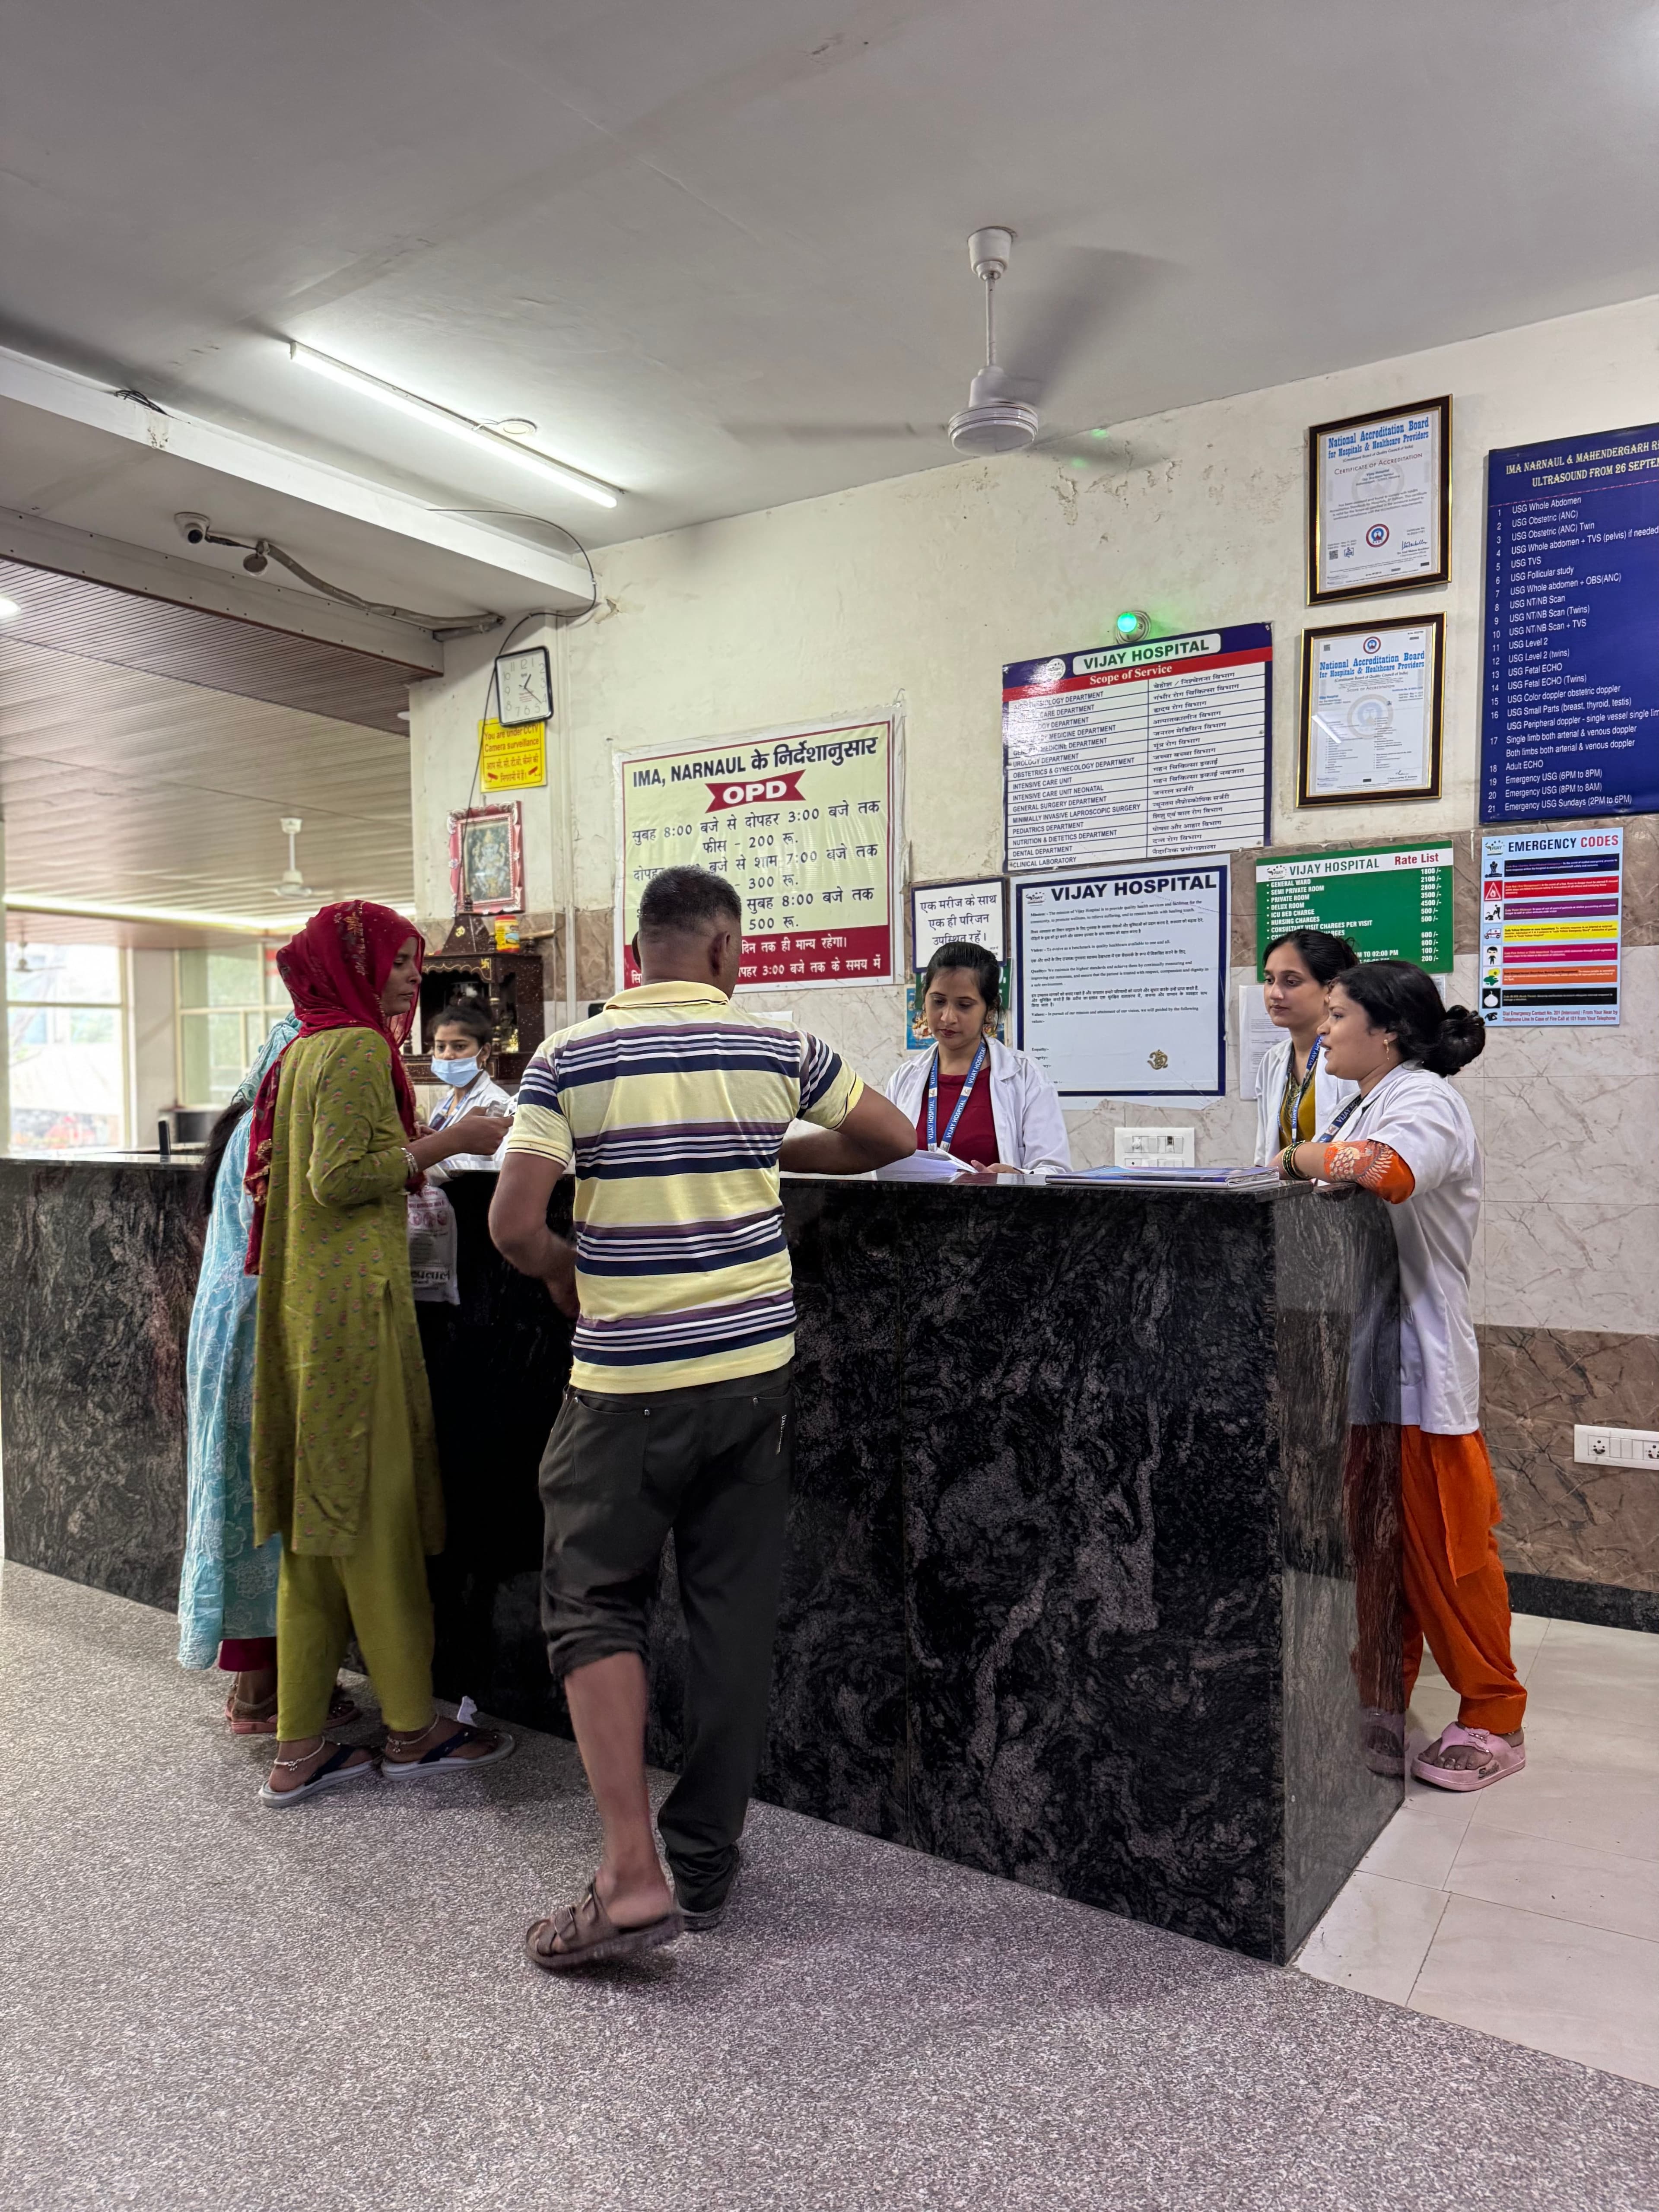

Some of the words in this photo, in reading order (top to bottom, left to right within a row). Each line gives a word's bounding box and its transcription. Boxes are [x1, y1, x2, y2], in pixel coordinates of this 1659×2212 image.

[1328, 433, 1356, 448] National
[1360, 424, 1404, 441] Accreditation
[1408, 417, 1429, 431] Board
[1338, 445, 1362, 457] Hospitals
[1373, 437, 1400, 449] Healthcare
[1403, 432, 1429, 442] Providers
[1506, 464, 1522, 474] IMA
[1524, 457, 1565, 471] NARNAUL
[1567, 455, 1573, 464] &
[1576, 442, 1649, 463] MAHENDERGARH
[1532, 470, 1587, 487] ULTRASOUND
[1589, 466, 1613, 477] FROM
[1615, 463, 1626, 474] 26
[1512, 504, 1527, 513] USG
[1529, 502, 1549, 511] Whole
[1551, 497, 1581, 507] Abdomen
[1510, 600, 1524, 609] USG
[1526, 596, 1548, 606] NT/NB
[1549, 594, 1565, 603] Scan
[1084, 652, 1127, 669] VIJAY
[1132, 639, 1209, 662] HOSPITAL
[1320, 660, 1348, 670] National
[1353, 654, 1399, 666] Accreditation
[1404, 651, 1424, 661] Board
[1090, 673, 1119, 685] Scope
[1122, 670, 1132, 680] of
[1135, 664, 1172, 677] Service
[484, 732, 495, 740] You
[507, 728, 522, 737] under
[524, 725, 538, 734] CCTV
[485, 744, 506, 752] Camera
[507, 738, 539, 750] surveillance
[633, 769, 665, 787] IMA,
[671, 756, 746, 782] NARNAUL
[751, 749, 770, 770] के
[773, 737, 878, 767] निर्देशानुसार
[1506, 762, 1522, 770] Adult
[1523, 760, 1543, 769] ECHO
[723, 781, 787, 804] OPD
[1013, 792, 1040, 801] INTENSIVE
[1074, 785, 1103, 794] NEONATAL
[1505, 788, 1540, 799] Emergency
[1541, 786, 1557, 795] USG
[1559, 784, 1576, 795] (8PM
[1585, 782, 1602, 791] 8AM)
[1070, 807, 1110, 817] LAPROSCOPIC
[1112, 804, 1141, 812] SURGERY
[632, 829, 657, 845] सुबह
[664, 824, 692, 837] 8:00
[700, 817, 718, 833] बजे
[727, 814, 737, 830] से
[745, 812, 780, 827] दोपहर
[788, 808, 819, 822] 3:00
[828, 800, 849, 817] बजे
[858, 801, 880, 814] तक
[703, 837, 727, 853] फीस
[749, 835, 774, 848] 200
[1508, 838, 1576, 852] EMERGENCY
[1581, 835, 1618, 848] CODES
[633, 865, 665, 881] दोपह
[709, 857, 728, 872] बजे
[736, 855, 746, 870] से
[754, 855, 777, 868] शाम
[787, 851, 817, 864] 7:00
[826, 843, 847, 860] बजे
[856, 844, 878, 858] तक
[1039, 857, 1076, 865] LABORATORY
[1290, 864, 1321, 875] VIJAY
[1325, 858, 1379, 873] HOSPITAL
[1395, 855, 1417, 865] Rate
[1421, 853, 1439, 863] List
[749, 877, 774, 889] 300
[1051, 884, 1107, 901] VIJAY
[1114, 875, 1216, 896] HOSPITAL
[747, 897, 774, 914] सुबह
[782, 893, 813, 906] 8:00
[823, 886, 843, 903] बजे
[852, 888, 874, 901] तक
[920, 901, 937, 913] एक
[939, 896, 963, 909] मरीज
[965, 894, 975, 906] के
[977, 895, 997, 905] साथ
[749, 918, 774, 930] 500
[928, 918, 944, 931] एक
[947, 914, 957, 928] ही
[959, 913, 989, 925] परिजन
[761, 942, 776, 953] तक
[781, 937, 790, 952] ही
[796, 939, 816, 950] मान्य
[763, 965, 784, 976] 3:00
[790, 959, 804, 974] बजे
[810, 962, 826, 973] तक
[831, 957, 840, 971] के
[846, 959, 868, 970] समय
[968, 1070, 978, 1084] VIJAY
[974, 1047, 986, 1069] HOSPITAL
[946, 1124, 956, 1138] VIJAY
[952, 1100, 966, 1122] HOSPITAL
